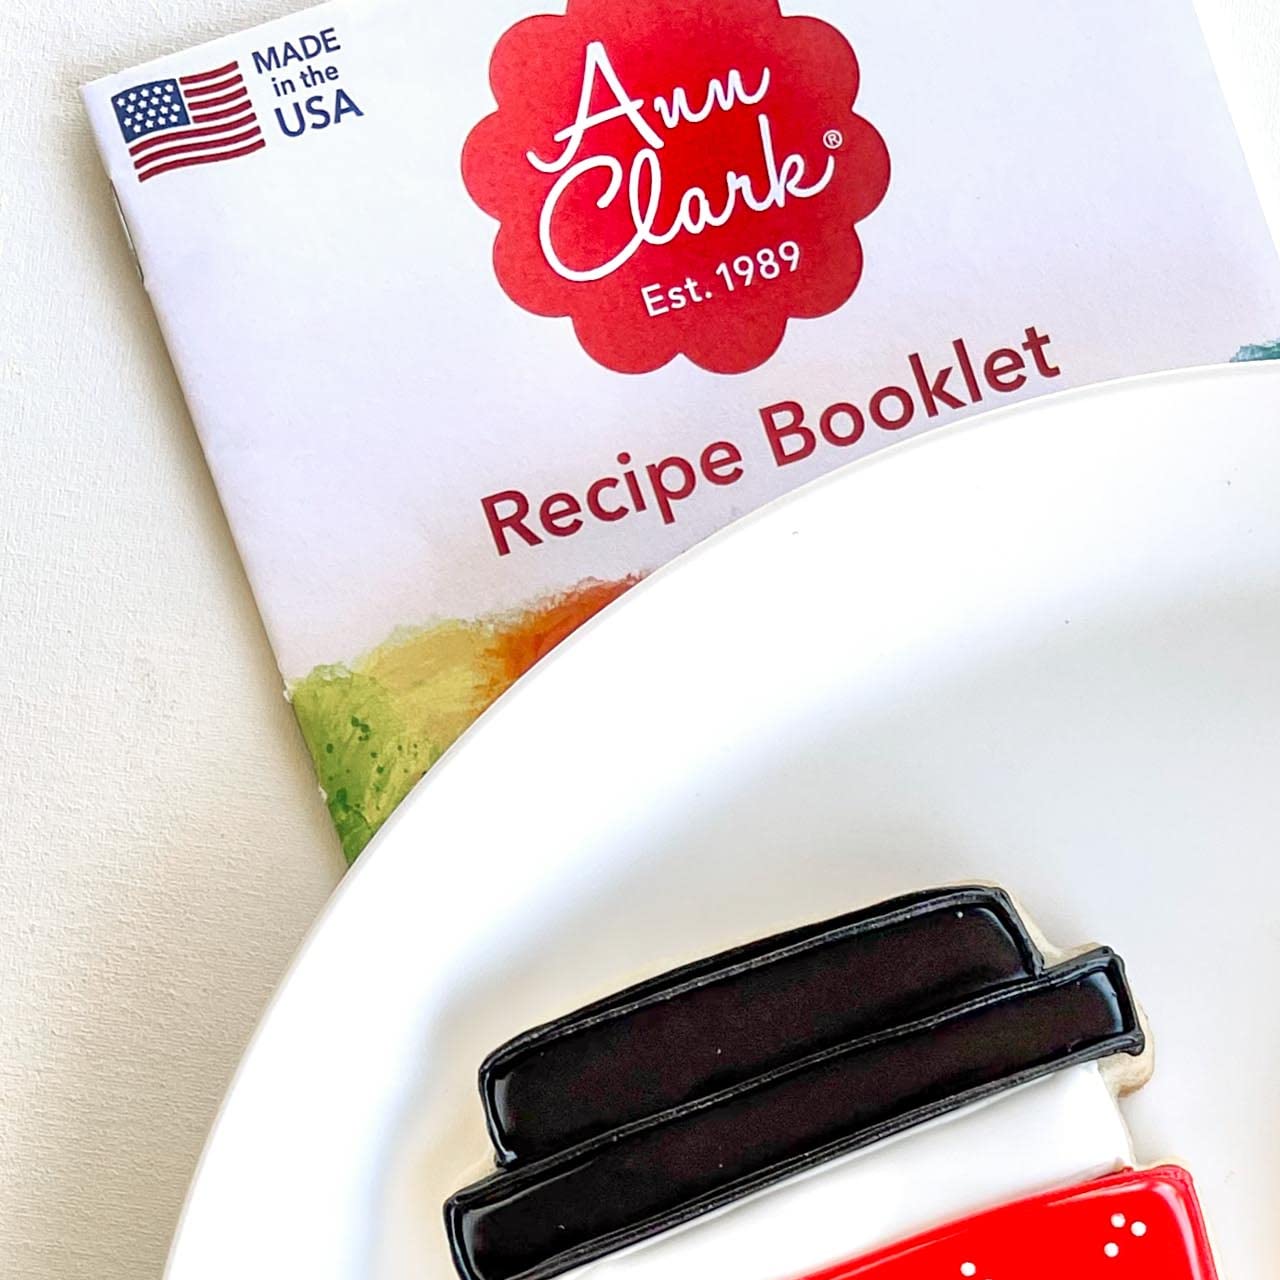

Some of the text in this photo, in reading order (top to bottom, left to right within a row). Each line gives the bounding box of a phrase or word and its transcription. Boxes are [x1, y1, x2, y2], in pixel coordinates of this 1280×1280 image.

[252, 27, 341, 74] MADE
[271, 64, 339, 97] in the
[274, 88, 364, 137] USA
[527, 41, 771, 173] Ann
[641, 240, 803, 318] Est. 1989
[480, 325, 1063, 557] Recipe Booklet
